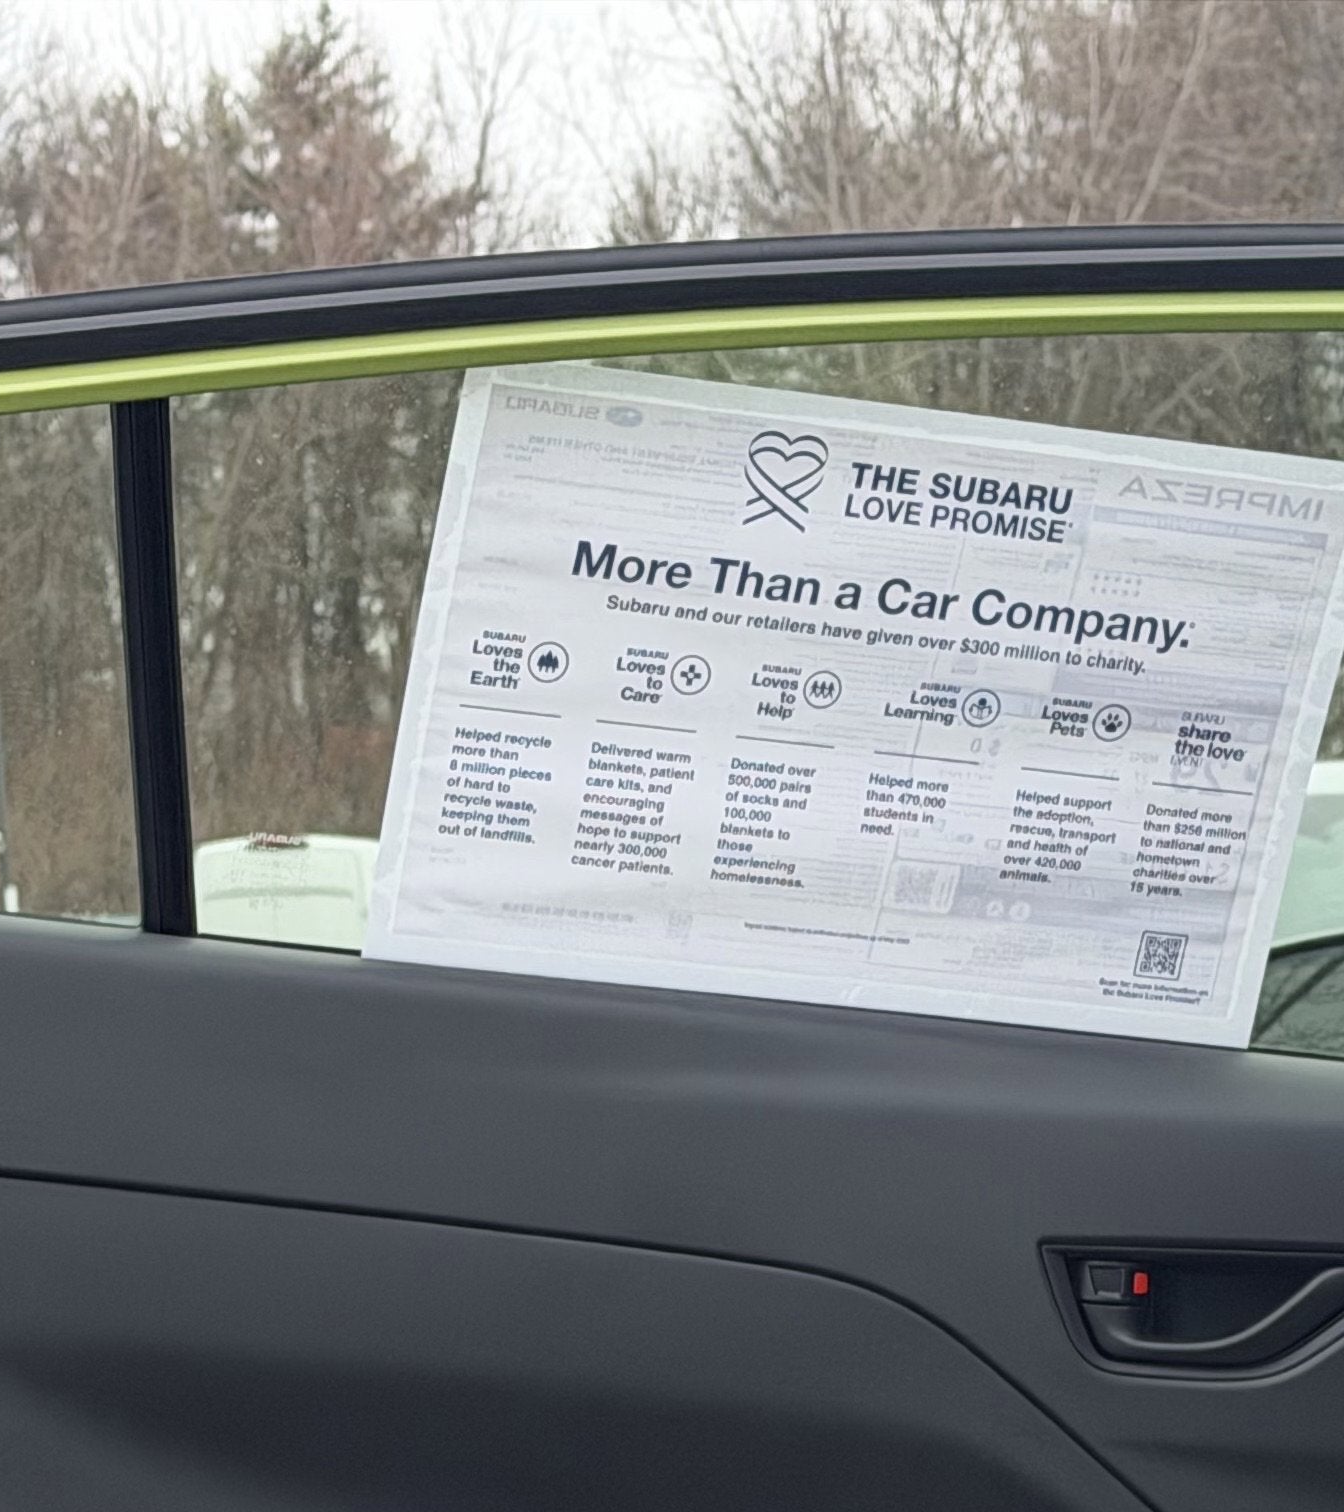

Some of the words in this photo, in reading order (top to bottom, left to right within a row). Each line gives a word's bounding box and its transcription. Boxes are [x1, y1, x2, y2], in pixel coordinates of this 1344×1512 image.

[852, 462, 920, 496] THE
[928, 472, 1073, 515] SUBARU
[844, 493, 923, 526] LOVE
[571, 540, 692, 597] More
[710, 557, 820, 605] Than
[834, 582, 862, 610] a
[877, 578, 960, 620] Car
[606, 594, 670, 617] Subaru
[674, 606, 708, 621] and
[712, 611, 742, 625] our
[746, 615, 816, 635] retailers
[821, 621, 863, 640] have
[866, 628, 913, 646] given
[918, 636, 957, 651] over
[959, 637, 1000, 656] $300
[1004, 644, 1060, 664] million
[1065, 642, 1082, 666] to
[1086, 651, 1146, 676] charity.
[472, 639, 523, 659] Loves
[493, 658, 521, 674] the
[616, 656, 665, 675] Loves
[646, 675, 663, 690] to
[751, 672, 799, 691] Loves
[780, 691, 796, 704] to
[909, 690, 957, 709] Loves
[884, 702, 955, 726] Learning
[1040, 705, 1089, 724] Loves
[454, 727, 502, 743] Helped
[504, 734, 552, 749] recycle
[1178, 723, 1231, 743] share
[452, 745, 486, 757] more
[490, 747, 519, 761] than
[591, 741, 653, 760] Delivered
[656, 751, 691, 764] warm
[1175, 739, 1205, 757] the
[1206, 741, 1245, 762] love
[461, 762, 506, 776] million
[508, 766, 552, 782] pieces
[649, 767, 695, 781] patient
[730, 757, 785, 775] Donated
[787, 766, 816, 777] over
[446, 776, 461, 787] of
[463, 777, 494, 791] hard
[497, 781, 511, 793] to
[585, 777, 614, 789] care
[647, 783, 672, 795] and
[728, 773, 777, 790] 500,000
[778, 781, 811, 794] pairs
[868, 772, 914, 789] Helped
[916, 781, 949, 793] more
[443, 793, 492, 807] recycle
[495, 799, 537, 814] waste,
[583, 793, 665, 813] encouraging
[725, 790, 740, 802] of
[742, 794, 779, 807] socks
[782, 798, 807, 810] and
[866, 789, 894, 803] than
[897, 792, 946, 809] 470,000
[1016, 789, 1061, 805] Helped
[1063, 797, 1112, 811] support
[441, 806, 494, 826] keeping
[497, 813, 530, 827] them
[580, 809, 646, 826] messages
[649, 815, 664, 826] of
[724, 806, 772, 822] 100,000
[863, 806, 918, 822] students
[921, 812, 934, 824] in
[1013, 806, 1033, 819] the
[1146, 803, 1198, 819] Donated
[1200, 812, 1232, 824] more
[438, 824, 460, 835] out
[463, 826, 478, 837] of
[577, 822, 610, 838] hope
[613, 826, 627, 838] to
[630, 830, 681, 845] support
[720, 822, 774, 839] blankets
[777, 829, 790, 840] to
[860, 823, 894, 836] need.
[1058, 827, 1117, 844] transport
[1143, 819, 1171, 833] than
[1205, 827, 1247, 841] million
[574, 840, 615, 855] nearly
[617, 842, 667, 859] 300,000
[717, 838, 753, 853] those
[1006, 839, 1031, 850] and
[1033, 840, 1072, 854] health
[1075, 844, 1089, 856] of
[1140, 836, 1153, 847] to
[1155, 838, 1205, 852] national
[1207, 844, 1231, 855] and
[571, 855, 616, 869] cancer
[617, 860, 673, 875] patients.
[713, 855, 796, 875] experiencing
[1003, 855, 1032, 866] over
[1136, 851, 1200, 868] hometown
[1188, 874, 1217, 884] over
[1146, 884, 1182, 897] years.
